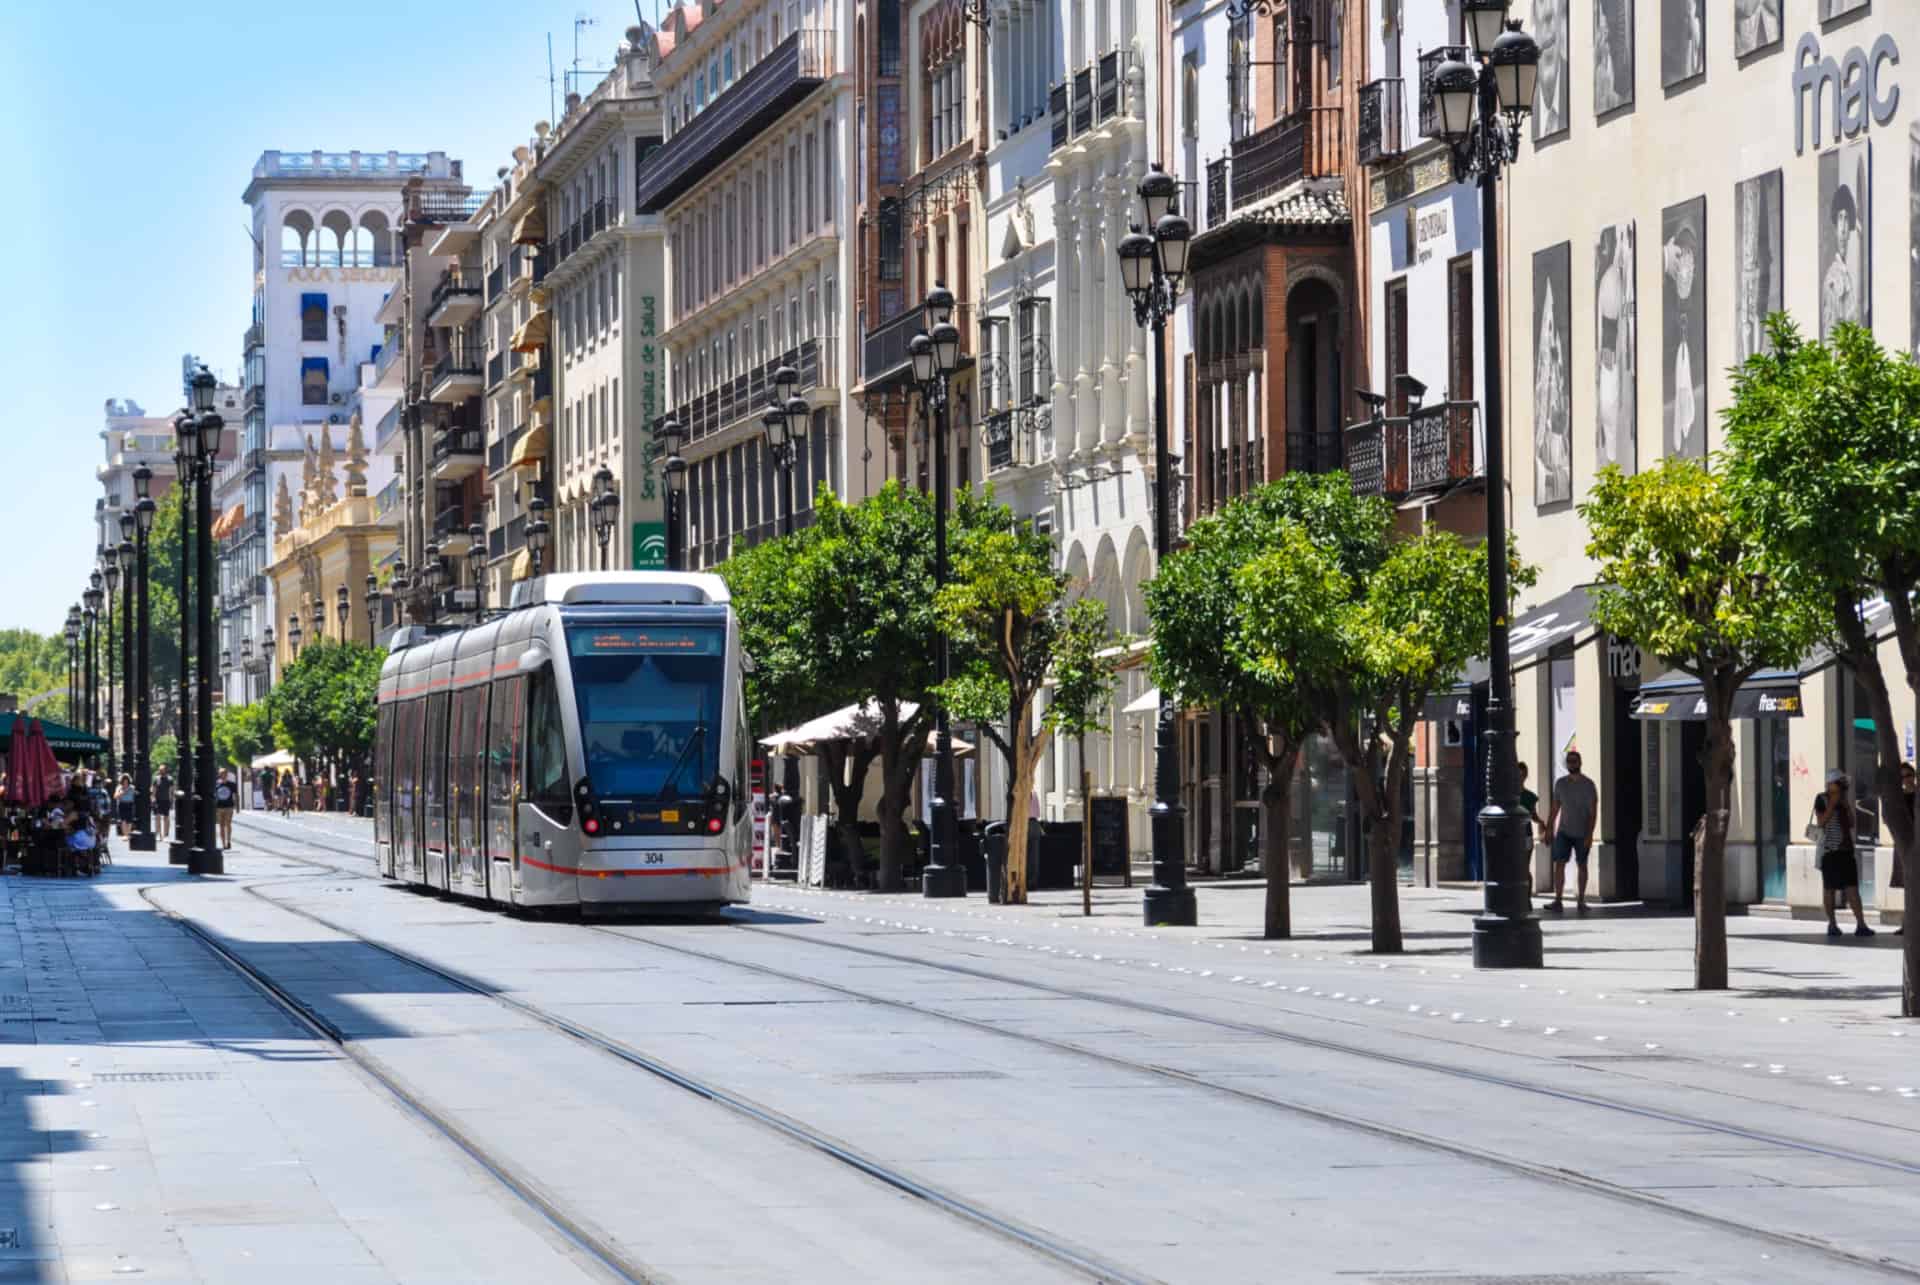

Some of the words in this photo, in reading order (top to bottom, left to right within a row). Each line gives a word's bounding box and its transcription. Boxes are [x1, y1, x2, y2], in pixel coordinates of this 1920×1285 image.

[1792, 31, 1900, 157] fnac
[288, 267, 333, 283] AXA
[640, 296, 656, 337] Salud
[641, 343, 655, 365] de
[641, 370, 656, 433] Andaluz
[644, 852, 664, 865] 304
